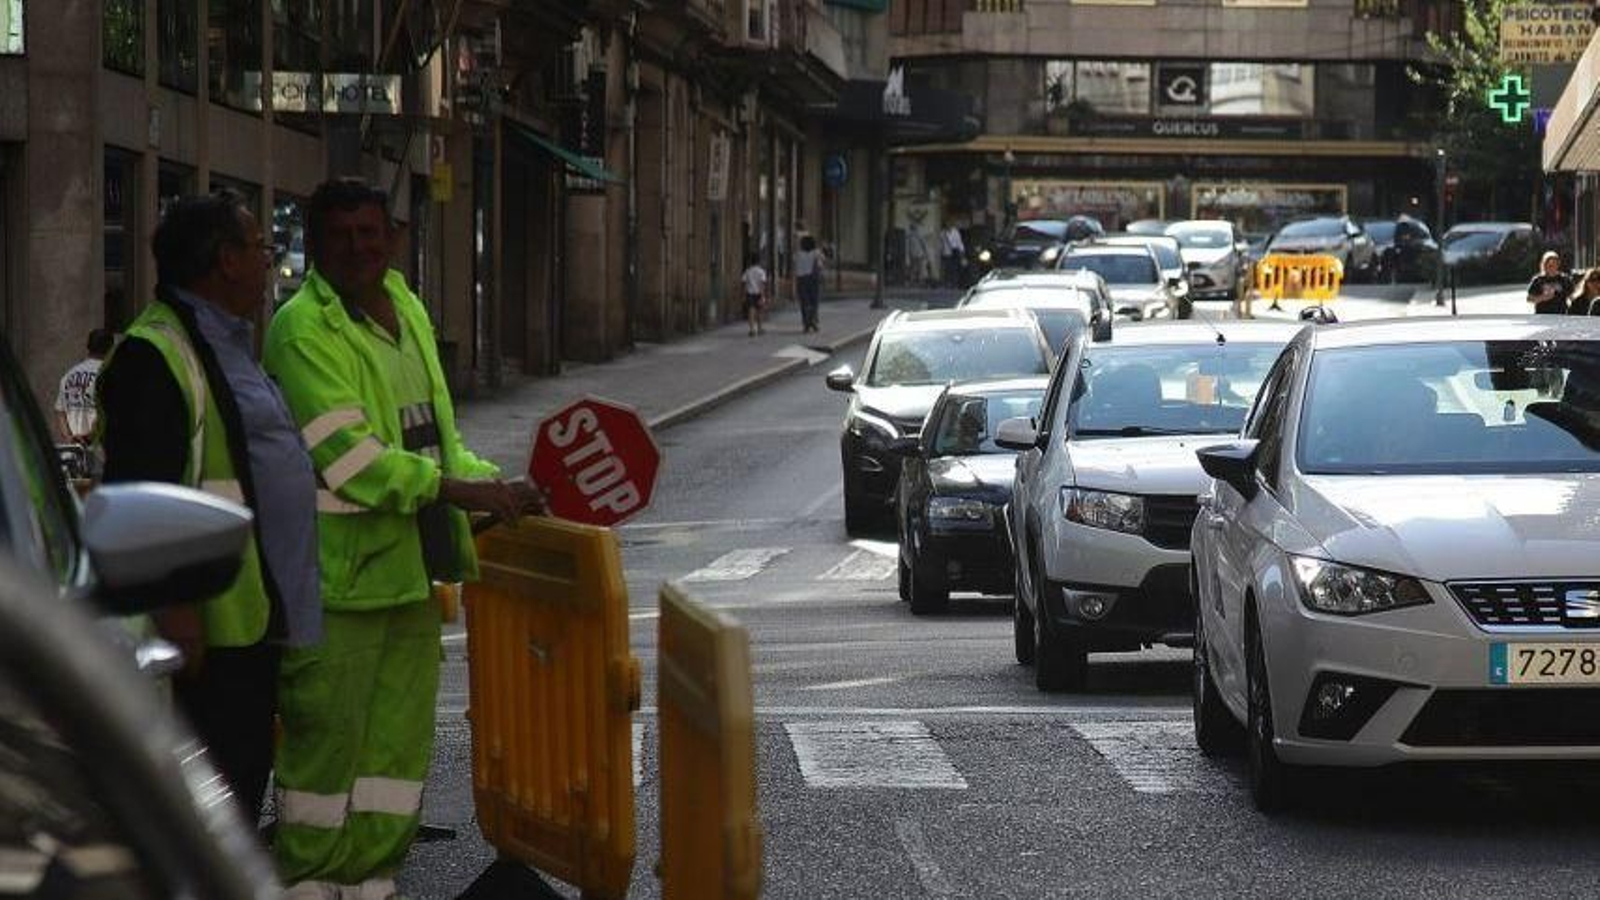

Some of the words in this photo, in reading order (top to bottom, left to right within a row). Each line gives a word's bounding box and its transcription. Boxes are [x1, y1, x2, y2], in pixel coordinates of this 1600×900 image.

[1152, 121, 1219, 135] QUERCUS
[548, 407, 640, 514] STOP
[1519, 649, 1596, 676] 7278
